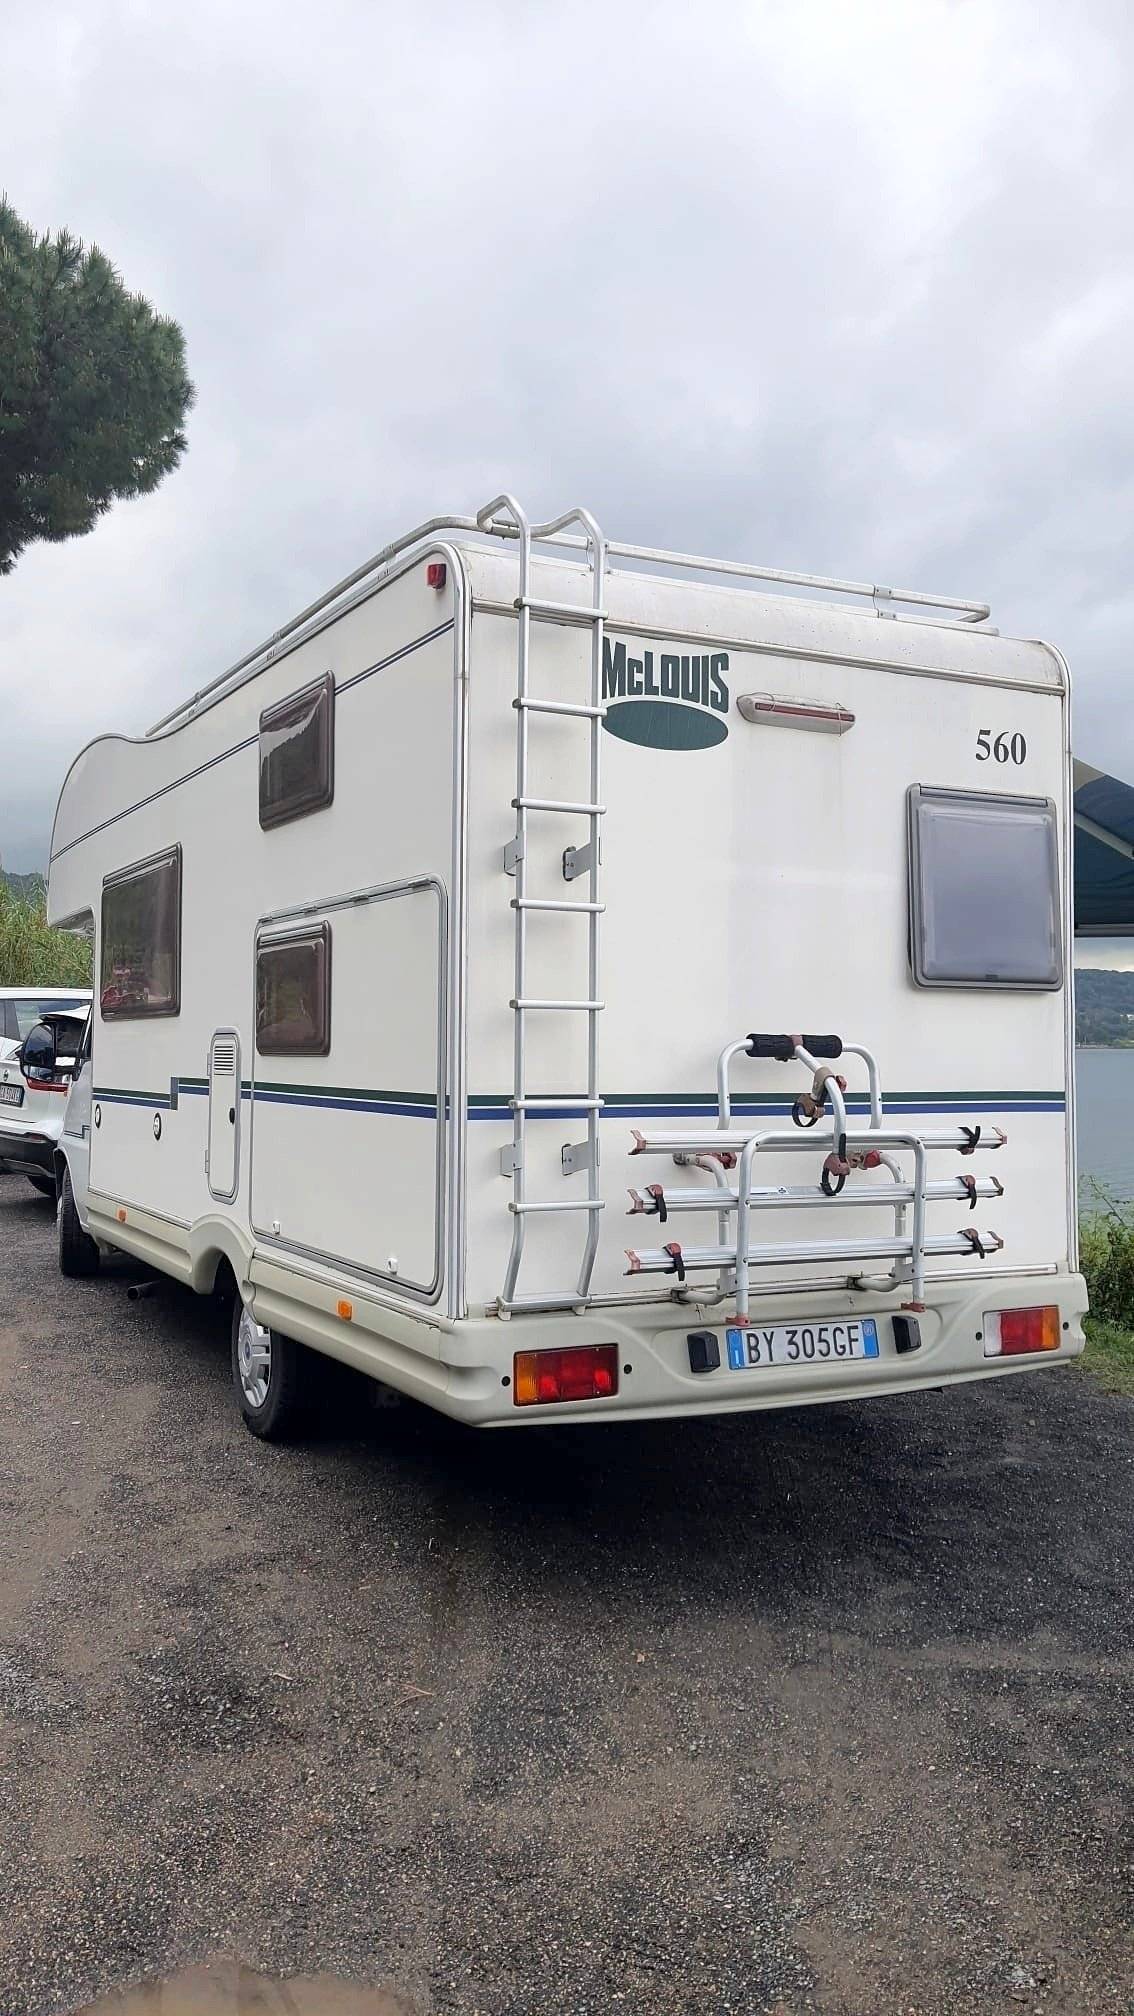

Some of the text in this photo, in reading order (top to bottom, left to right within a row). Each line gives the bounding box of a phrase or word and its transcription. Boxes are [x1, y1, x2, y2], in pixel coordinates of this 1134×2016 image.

[601, 636, 729, 714] McLOUIS
[975, 729, 1027, 765] 560
[746, 1325, 859, 1364] BY 305GF
